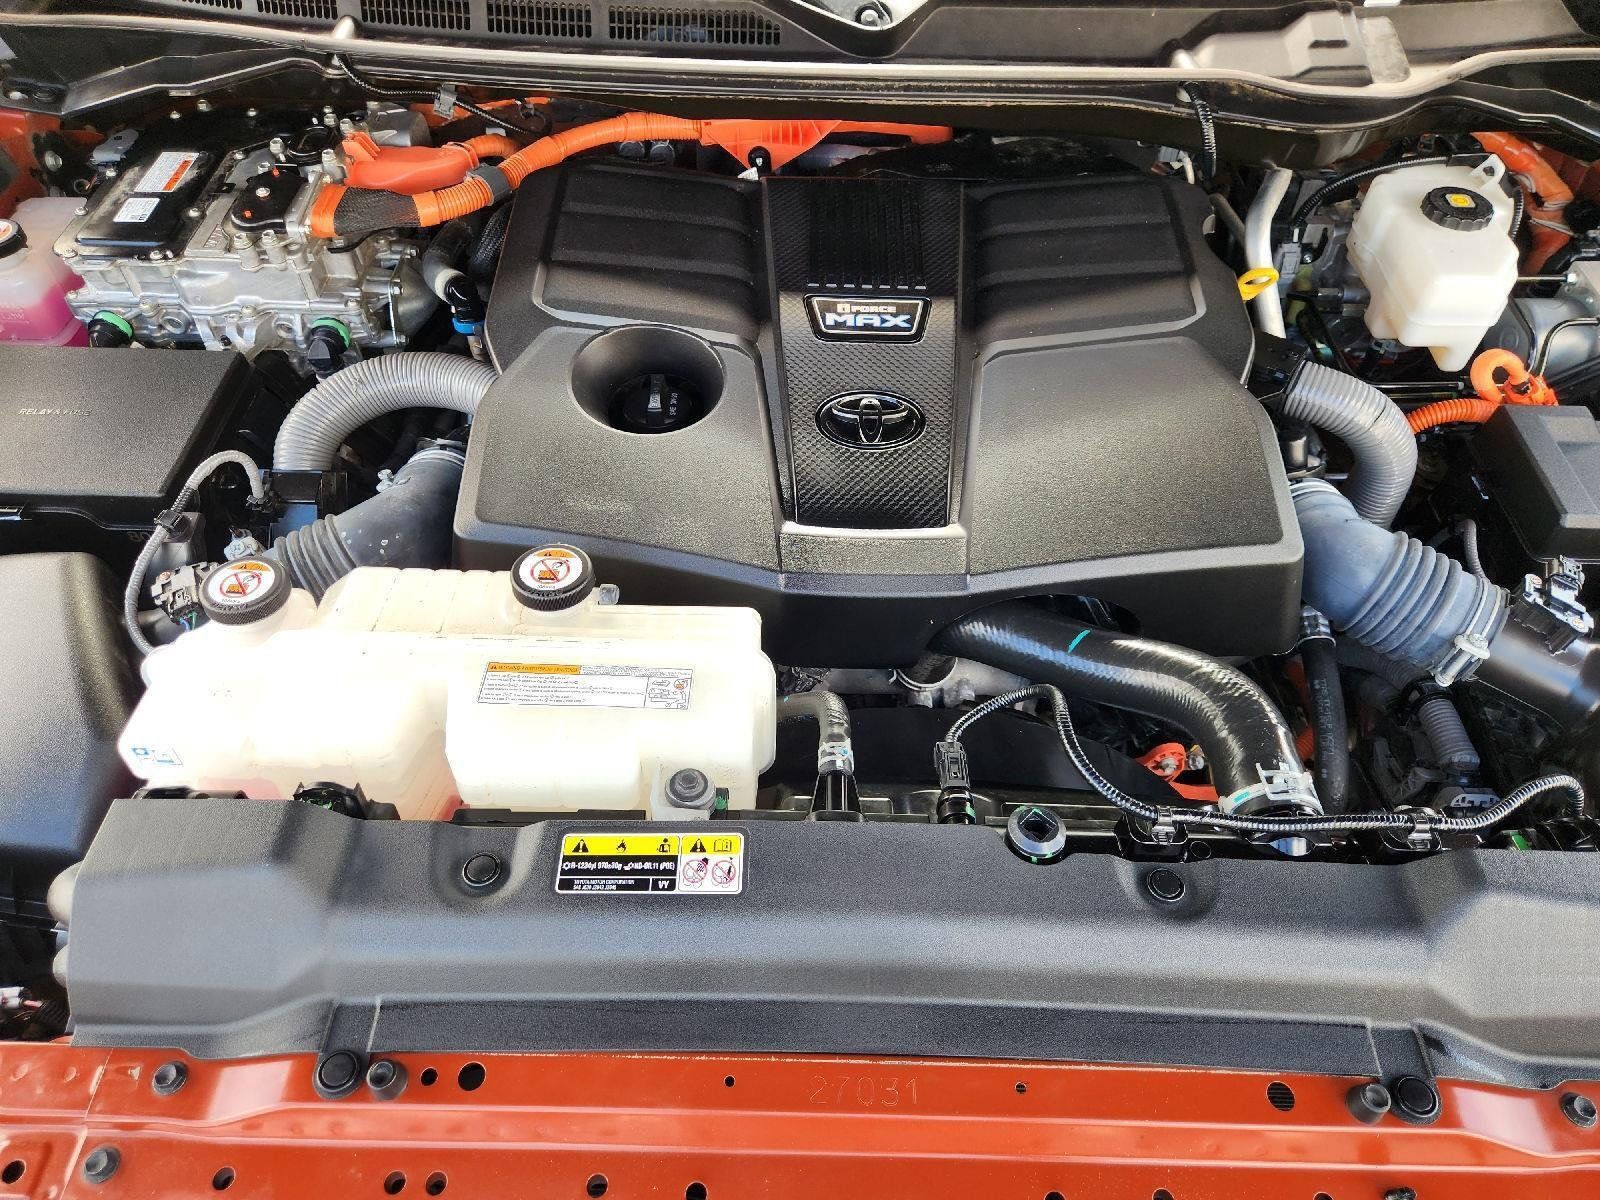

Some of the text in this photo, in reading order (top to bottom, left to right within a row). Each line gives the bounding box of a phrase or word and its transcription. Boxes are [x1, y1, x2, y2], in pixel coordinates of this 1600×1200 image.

[824, 312, 912, 328] MAX
[658, 880, 670, 889] VY
[809, 1075, 920, 1107] 27031
